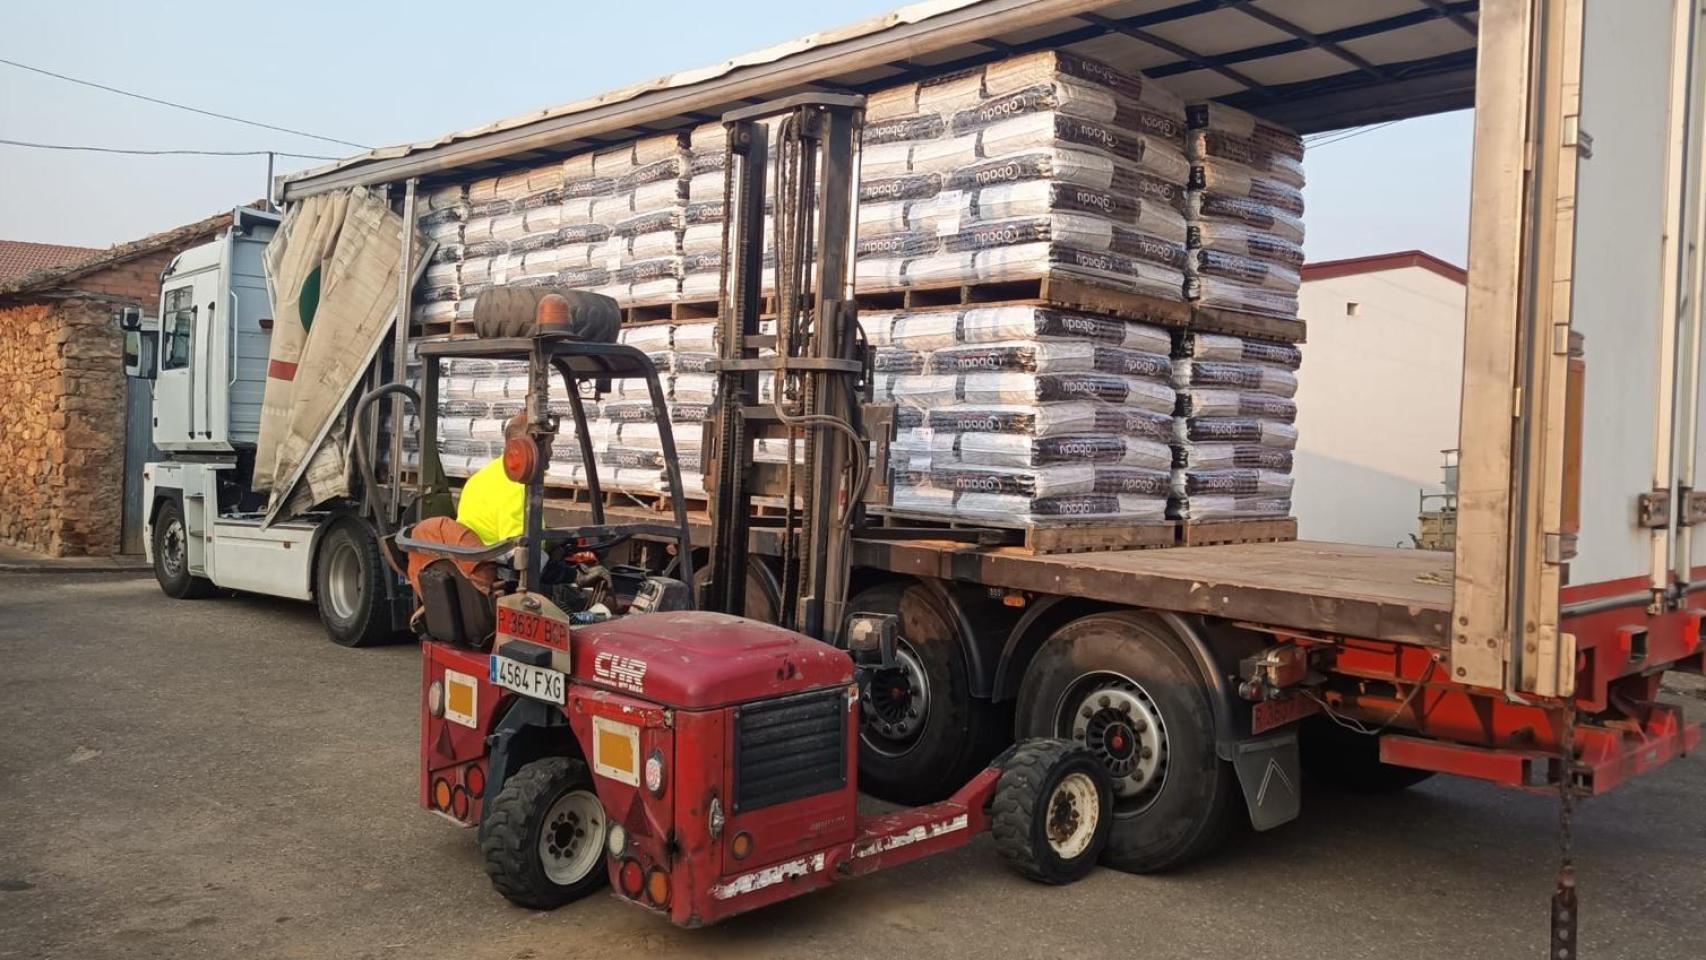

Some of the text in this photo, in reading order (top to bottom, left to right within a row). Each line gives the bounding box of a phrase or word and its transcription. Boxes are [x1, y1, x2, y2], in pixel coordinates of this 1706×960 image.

[980, 96, 1026, 121] Cobadu
[975, 161, 1021, 184] Cobadu
[974, 225, 1018, 245] Cobadu
[499, 660, 530, 690] 4564
[534, 671, 561, 699] FXG
[594, 651, 648, 686] CHR
